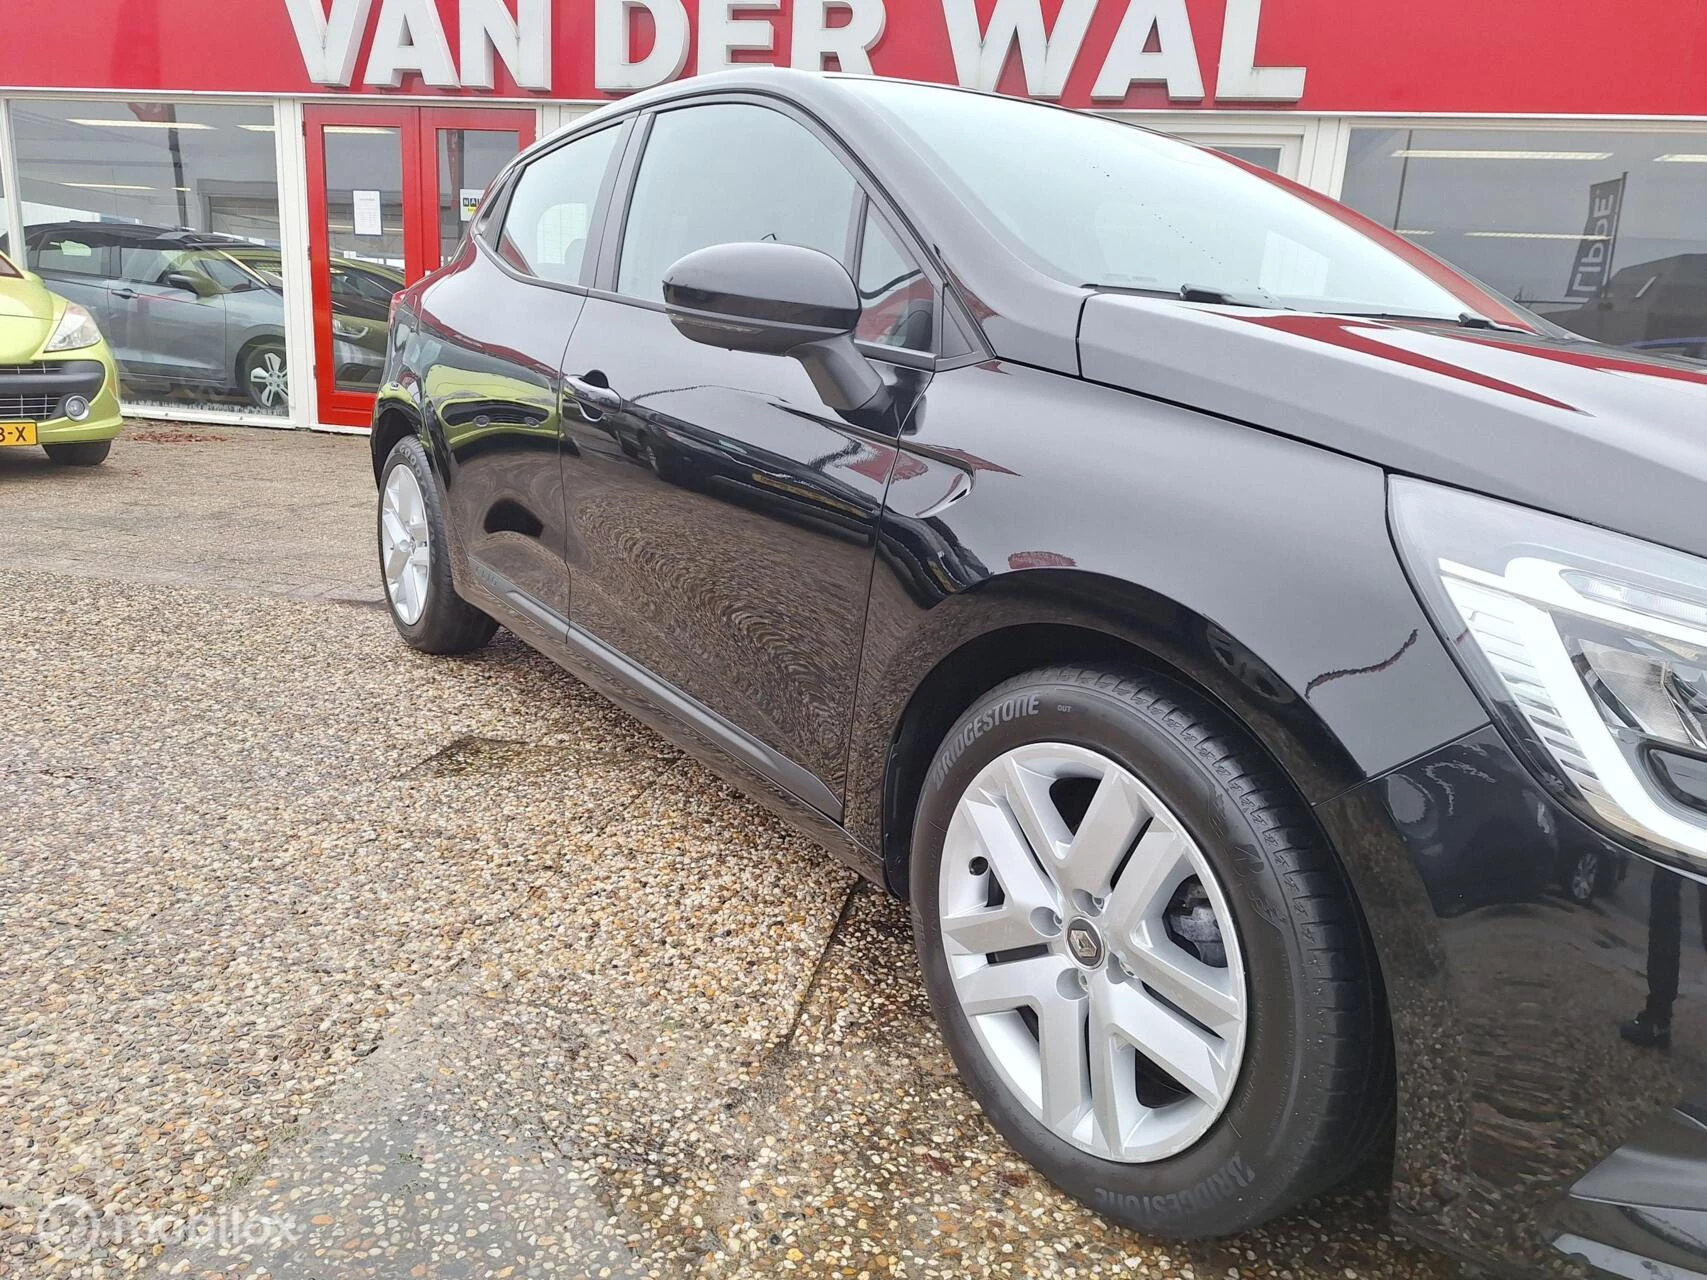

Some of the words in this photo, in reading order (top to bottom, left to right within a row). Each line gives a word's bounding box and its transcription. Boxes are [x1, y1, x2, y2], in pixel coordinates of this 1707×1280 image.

[284, 0, 551, 91] VAN
[595, 0, 886, 90] DER
[941, 0, 1307, 101] WAL
[462, 197, 480, 207] NA
[1057, 704, 1072, 713] OUT
[933, 692, 1041, 791] BRIDGESTONE
